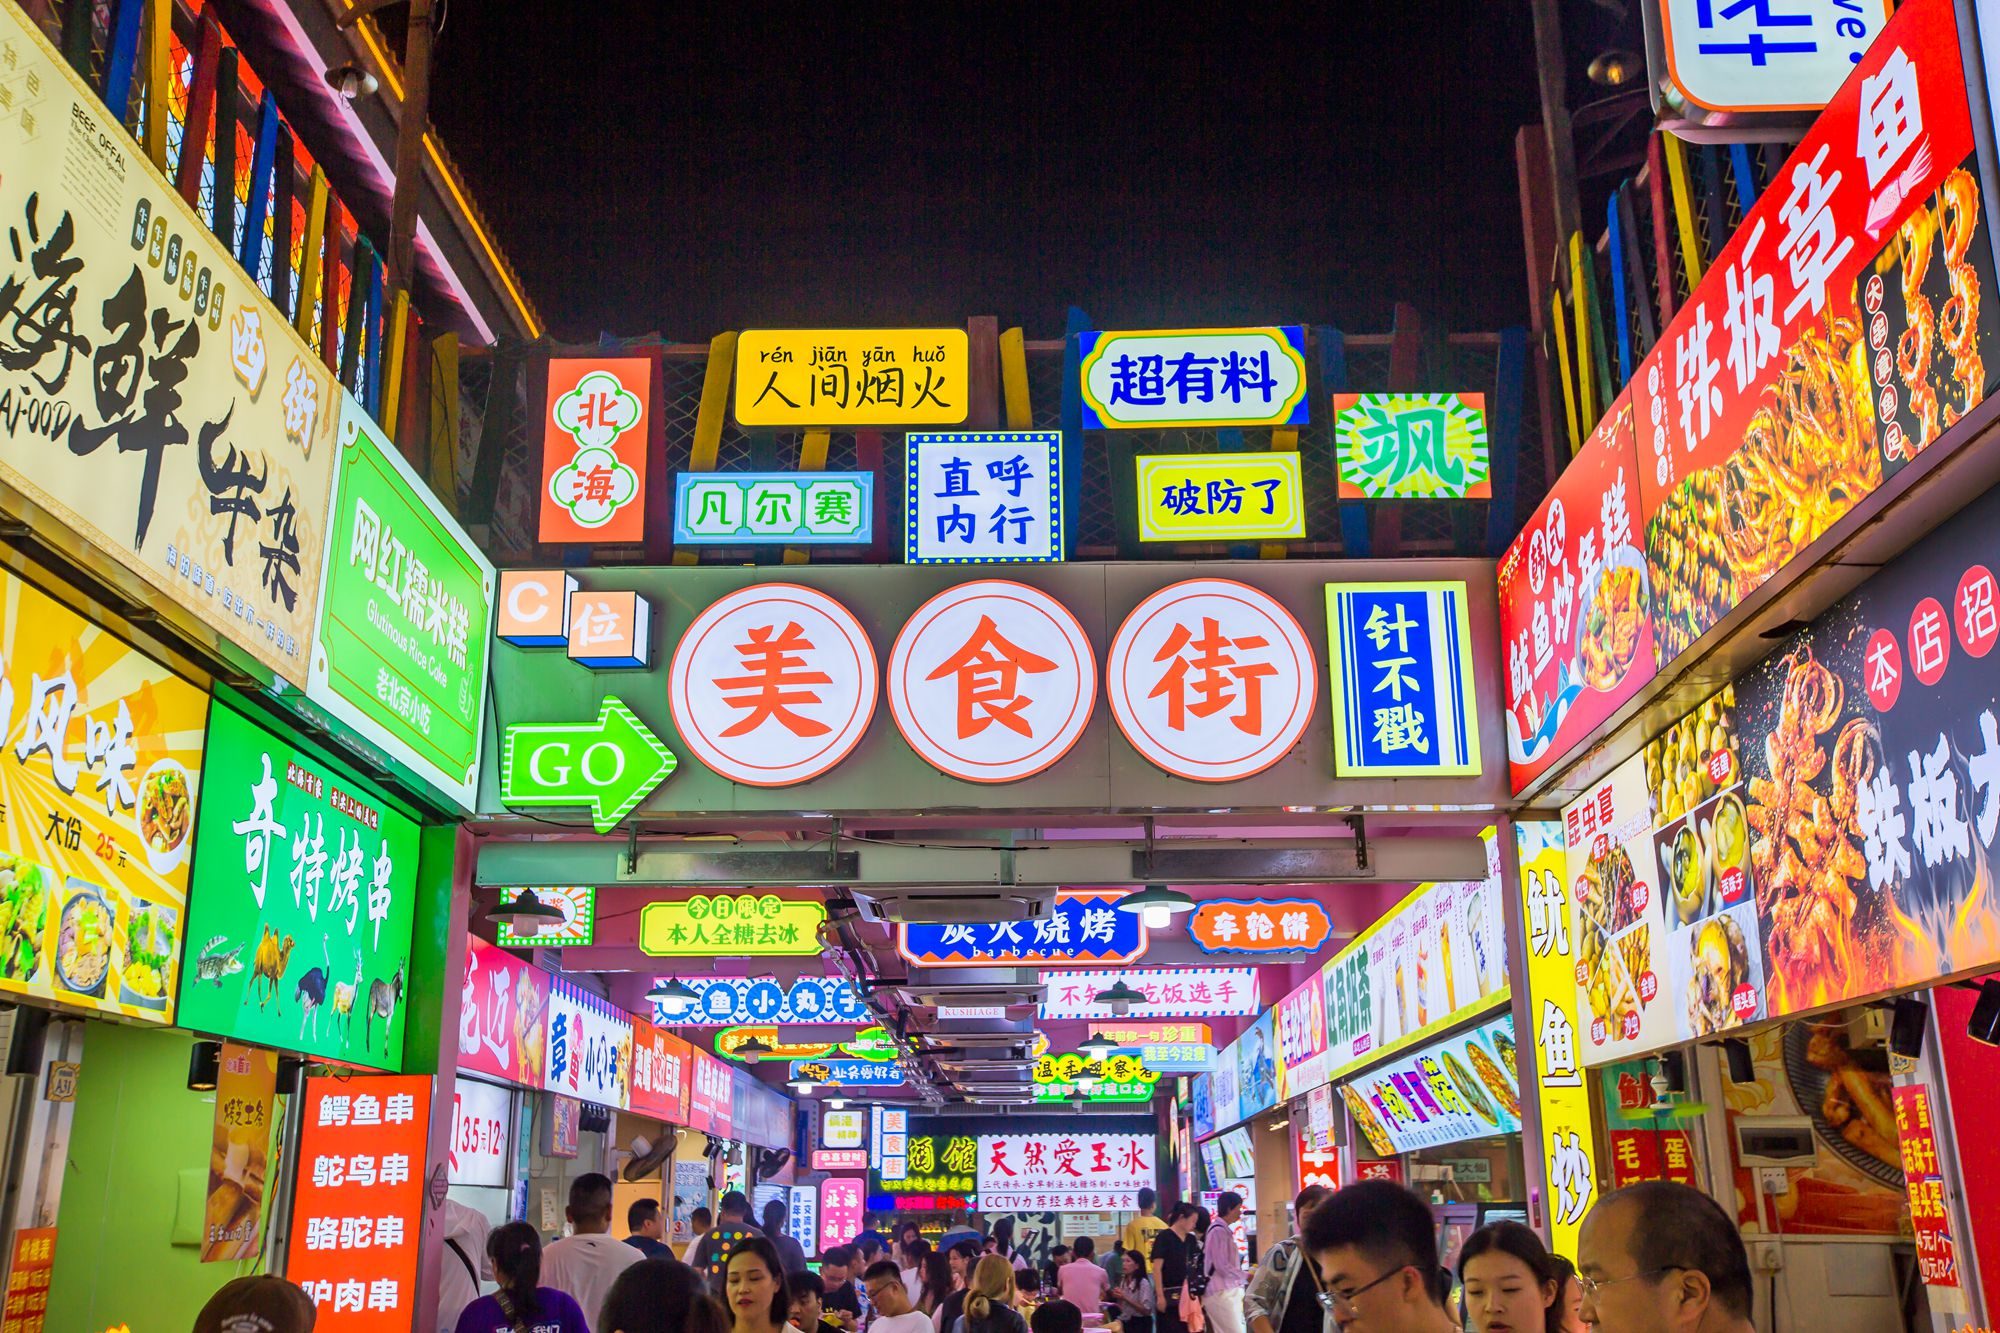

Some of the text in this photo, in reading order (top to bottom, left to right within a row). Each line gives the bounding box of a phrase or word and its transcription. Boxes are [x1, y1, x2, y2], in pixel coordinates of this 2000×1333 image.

[71, 102, 97, 135] BEEF
[99, 133, 126, 172] OFFAL
[1676, 45, 1923, 452] 铁板章鱼
[760, 346, 793, 364] rén
[812, 346, 848, 367] jiān
[861, 346, 896, 366] yān
[1110, 349, 1278, 406] 超有料
[752, 363, 951, 410] 人间烟火
[572, 391, 619, 507] 北海
[1360, 408, 1465, 486] 飒
[934, 455, 1034, 498] 直呼
[1160, 477, 1282, 516] 破防了
[695, 489, 853, 526] 凡尔赛
[935, 504, 1035, 545] 内行
[1530, 503, 1565, 587] 韩式
[349, 497, 471, 671] 网红糯米糕
[1509, 466, 1632, 708] 鱿鱼炒年糕
[367, 600, 448, 689] Glutinous Rice Cake
[712, 614, 1279, 739] 美食街
[1363, 603, 1429, 754] 针不戳
[376, 668, 432, 736] 老北京小吃
[0, 650, 136, 815] 风味
[529, 742, 624, 786] GO
[1710, 753, 1731, 780] 毛蛋
[1567, 784, 1615, 849] 昆虫宴
[45, 811, 81, 852] 大份
[95, 833, 116, 862] 25
[117, 850, 127, 869] 元
[233, 752, 392, 952] 奇特烤串
[1721, 873, 1743, 896] 活珠子
[689, 899, 782, 919] 今日限定
[940, 908, 1118, 945] 炭火烧烤
[1212, 911, 1310, 942] 车轮饼
[667, 923, 799, 945] 本人全糖去冰
[972, 946, 1075, 958] barbecue
[944, 1007, 999, 1017] KUSHIAGE
[1092, 1026, 1197, 1043] 年前你一句珍重
[318, 1093, 414, 1126] 鳄鱼串
[886, 1112, 903, 1175] 美食街
[988, 1138, 1150, 1177] 天然愛玉冰
[1902, 1138, 1935, 1174] 活珠子
[312, 1153, 409, 1187] 鸵鸟串
[985, 1195, 1132, 1208] CCTV力荐经典特色美食
[306, 1215, 404, 1250] 骆驼串
[301, 1278, 399, 1313] 驴肉串
